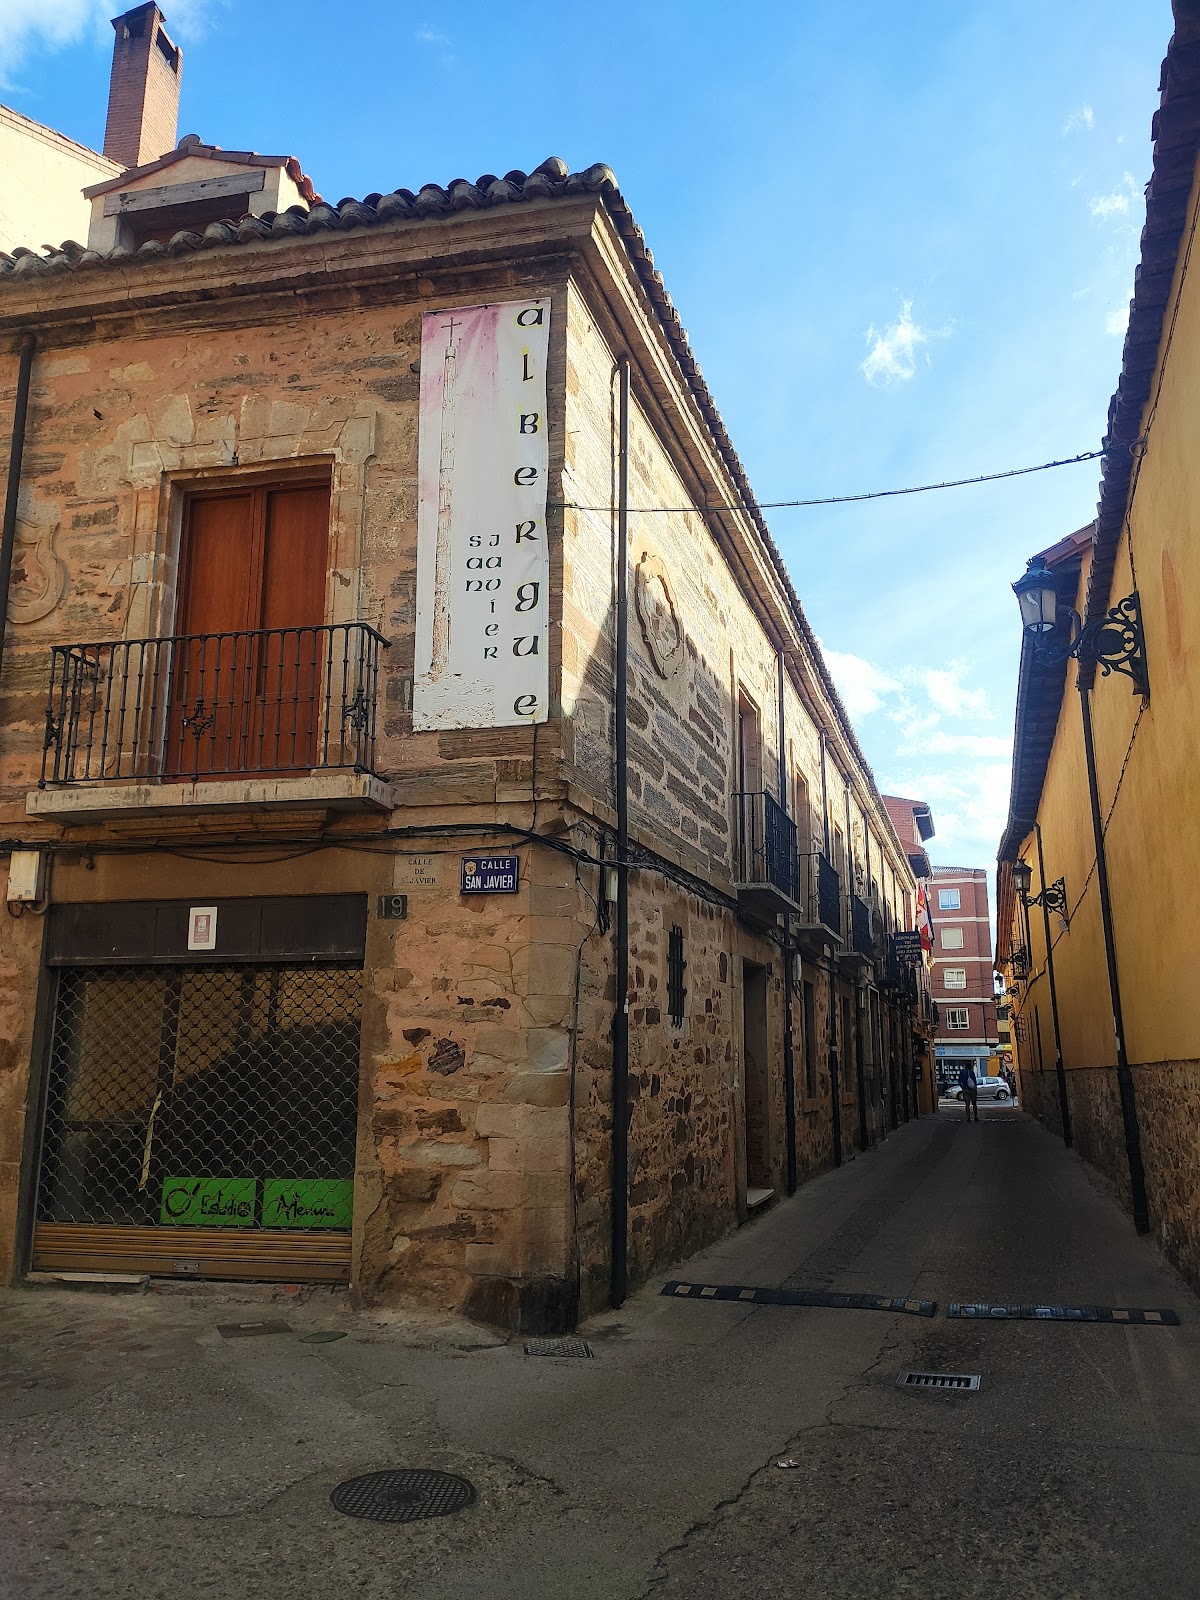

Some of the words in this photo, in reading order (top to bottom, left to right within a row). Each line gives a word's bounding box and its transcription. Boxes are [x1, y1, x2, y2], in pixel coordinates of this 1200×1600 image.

[408, 858, 433, 866] CALLE
[481, 860, 511, 870] CALLE
[409, 877, 436, 885] JAVIER
[465, 876, 481, 889] SAN
[484, 875, 513, 889] JAVIER
[380, 896, 403, 918] 19
